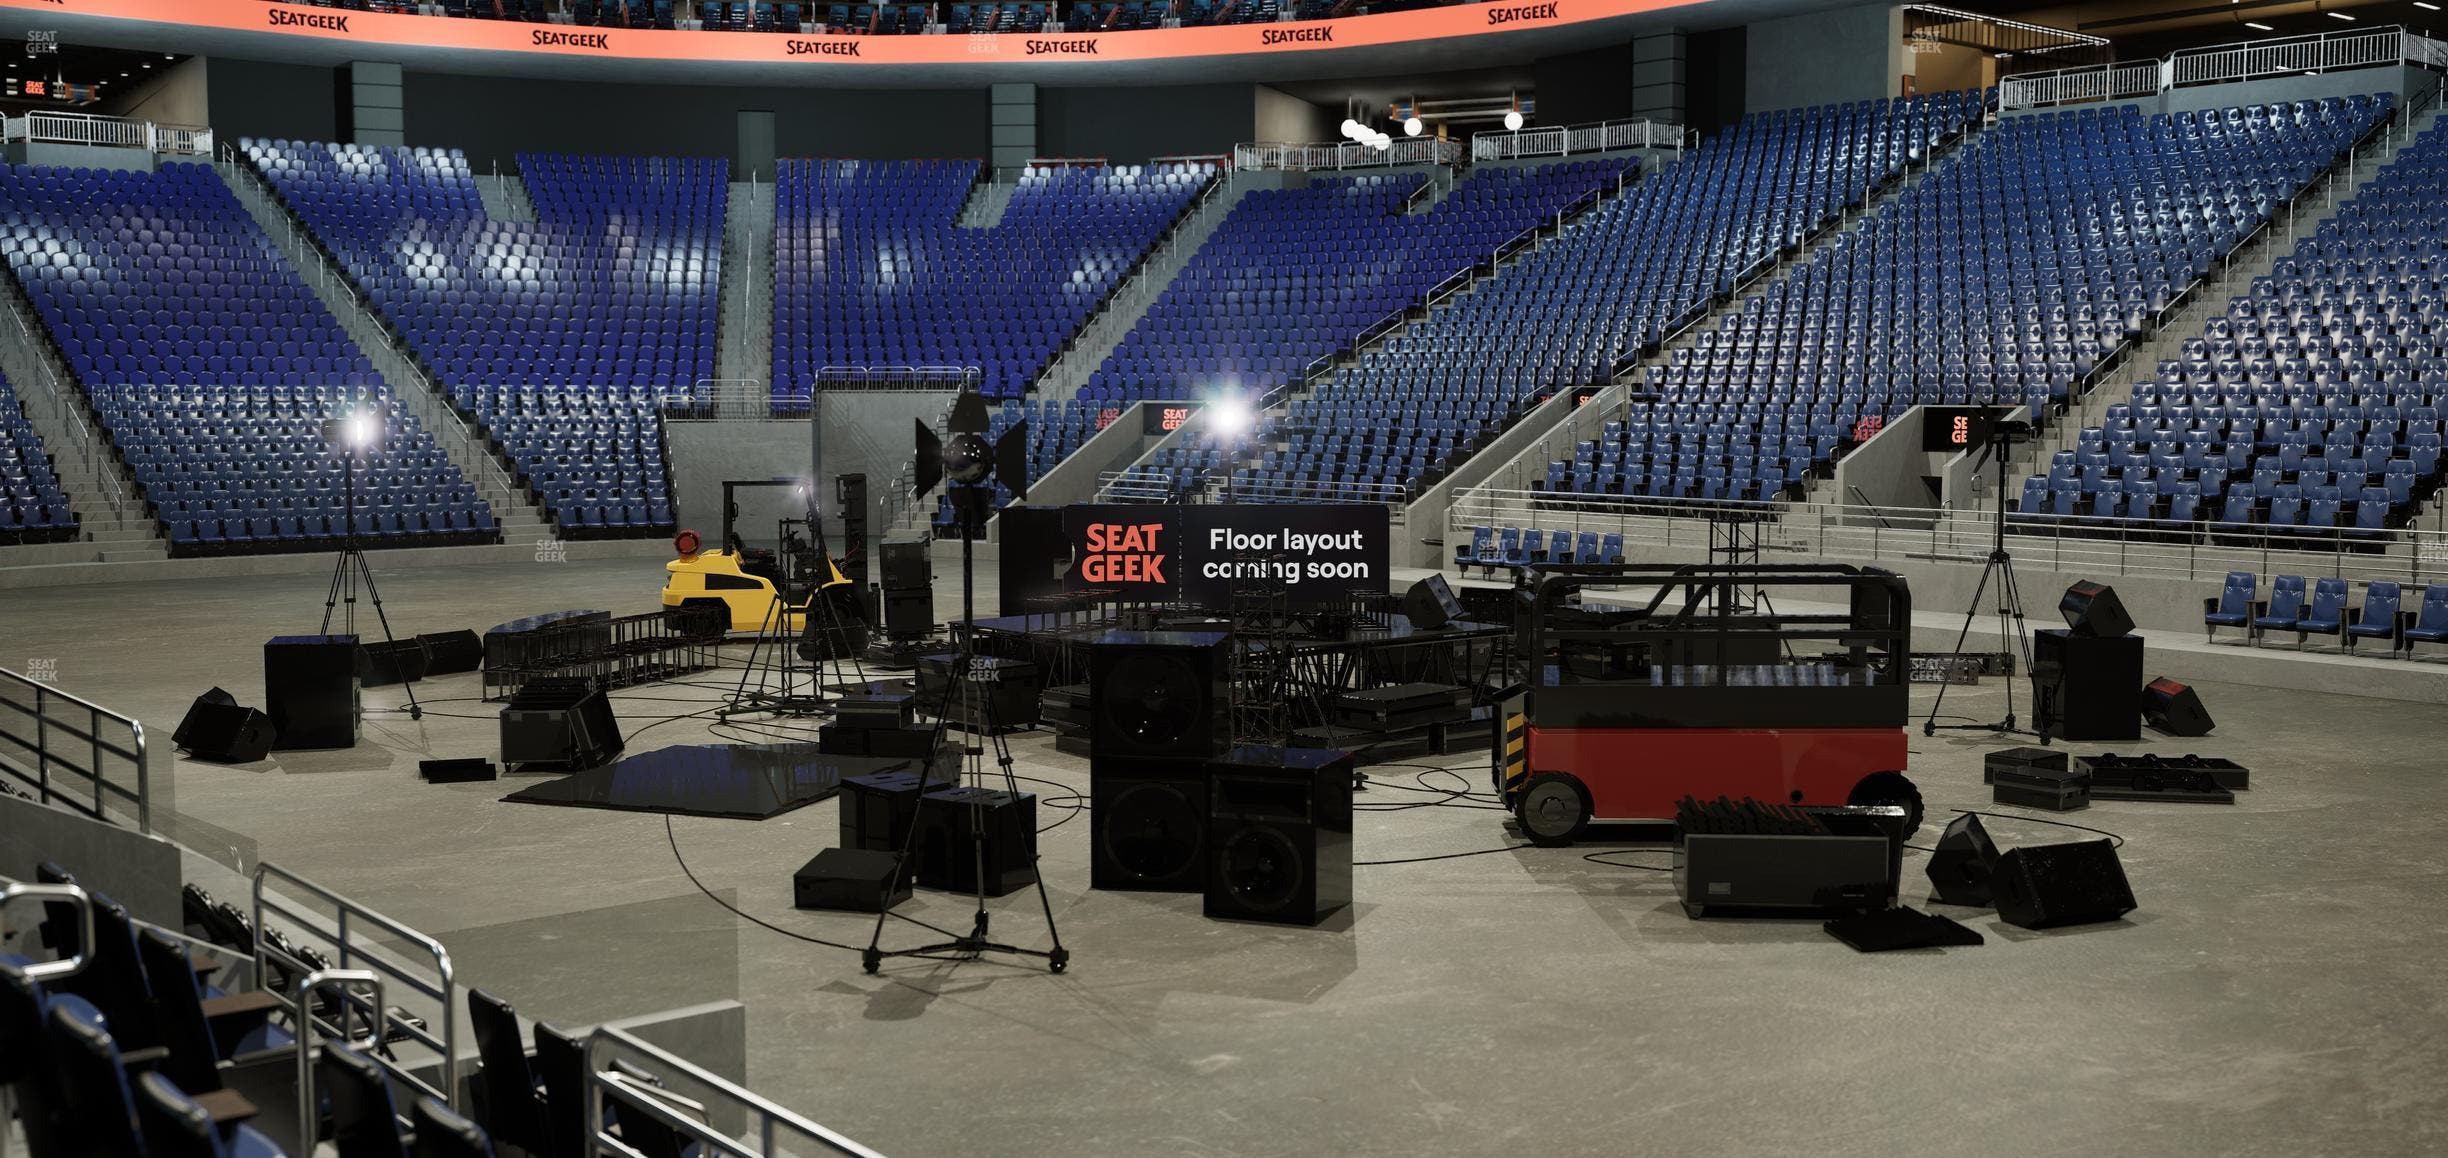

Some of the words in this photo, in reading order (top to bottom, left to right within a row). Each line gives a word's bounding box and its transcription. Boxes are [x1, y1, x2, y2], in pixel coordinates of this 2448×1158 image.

[269, 9, 349, 33] SEATGEEK
[1488, 3, 1558, 25] SEATGEEK
[533, 30, 609, 50] SEATGEEK
[1262, 26, 1333, 45] SEATGEEK
[787, 40, 860, 57] SEATGEEK
[1026, 39, 1098, 55] SEATGEEK
[1164, 409, 1188, 419] SEAT
[1086, 523, 1163, 552] SEAT
[1210, 528, 1277, 550] Floor
[1284, 528, 1363, 555] layout
[1081, 554, 1166, 584] GEEK
[1203, 560, 1300, 584] coming
[1307, 562, 1369, 579] soon
